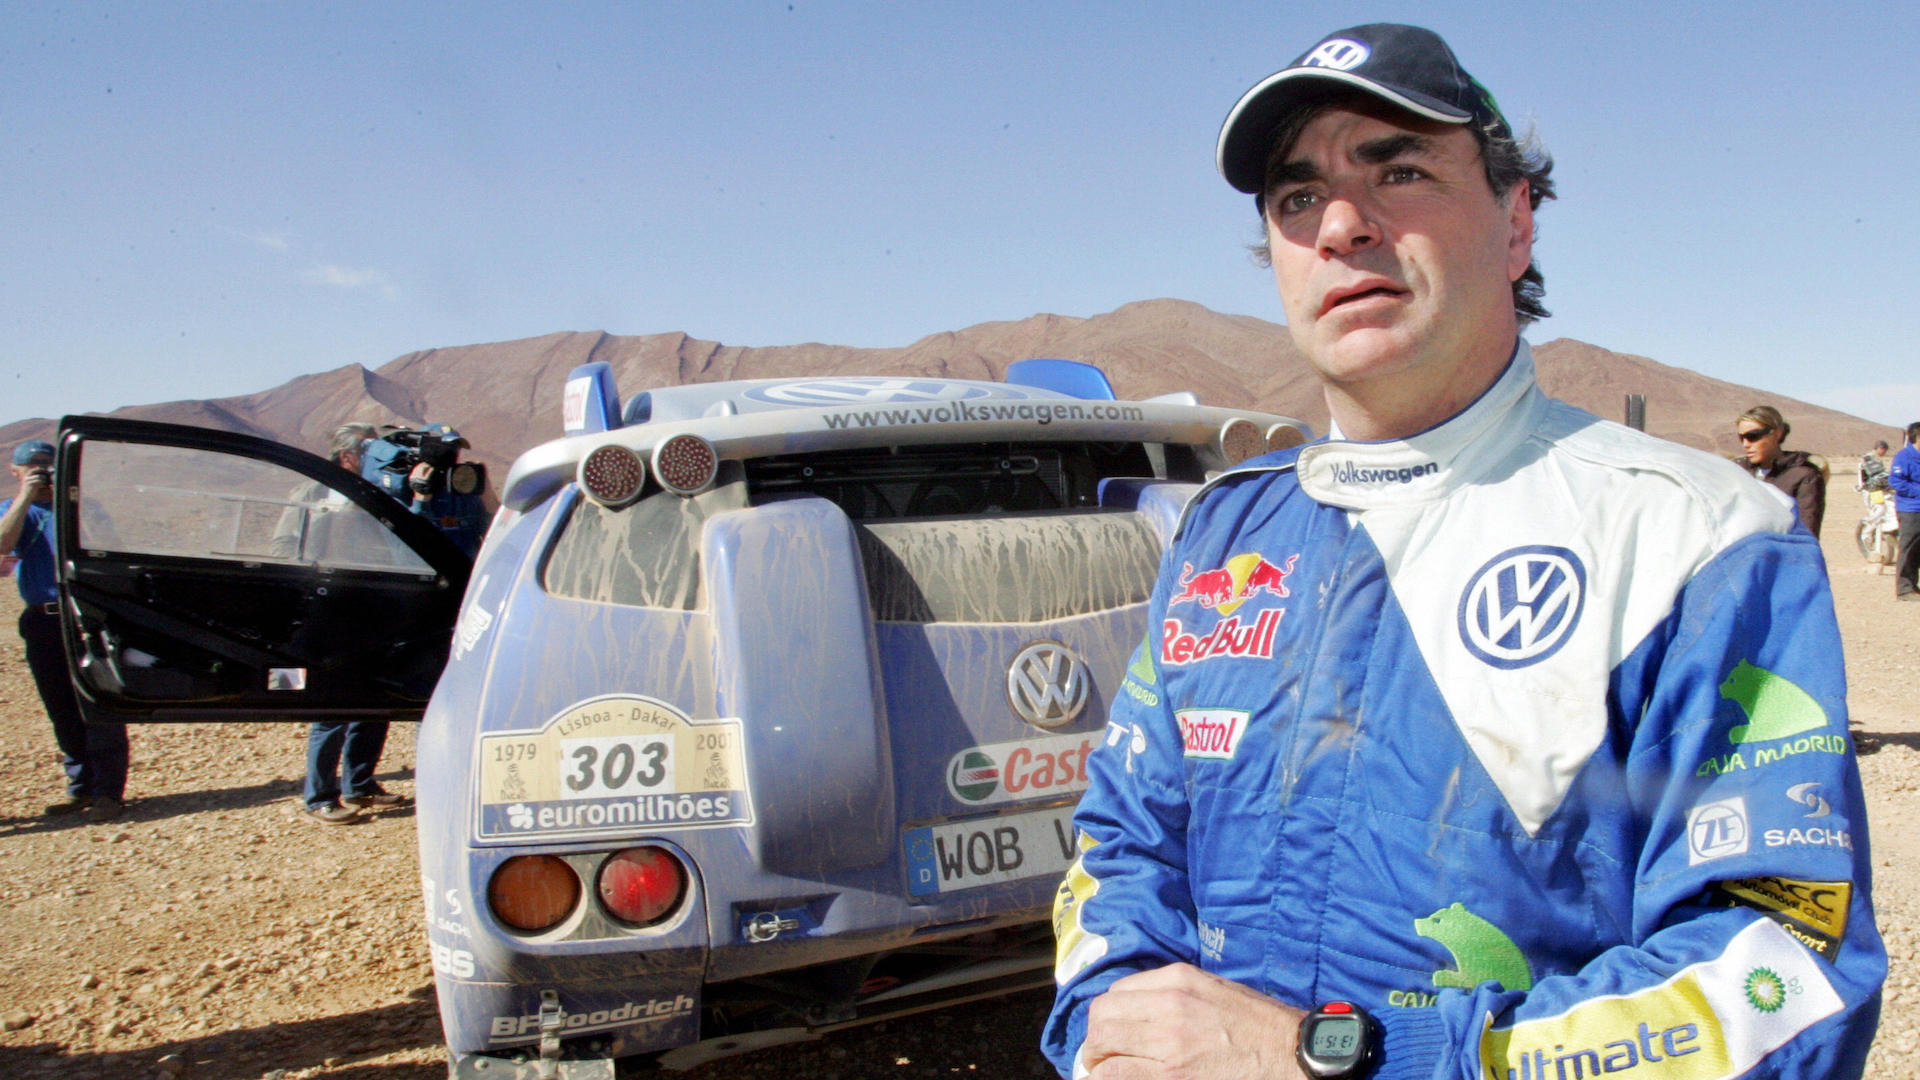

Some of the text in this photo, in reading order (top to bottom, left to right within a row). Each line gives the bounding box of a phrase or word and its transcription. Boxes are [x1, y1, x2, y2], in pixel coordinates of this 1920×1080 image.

[822, 400, 1145, 426] www.volkswagen.com
[1330, 460, 1439, 484] Volkswagen
[558, 711, 611, 736] Lisboa
[631, 707, 677, 731] Dakar
[495, 743, 537, 761] 1979
[696, 732, 731, 750] 200
[1754, 735, 1848, 768] MADRID
[566, 741, 669, 791] 303
[1003, 740, 1091, 794] Cast
[538, 793, 731, 829] euromilhões
[1695, 813, 1740, 852] ZF
[936, 826, 1024, 881] WOB
[920, 868, 931, 883] D
[490, 995, 694, 1036] BFoodrich
